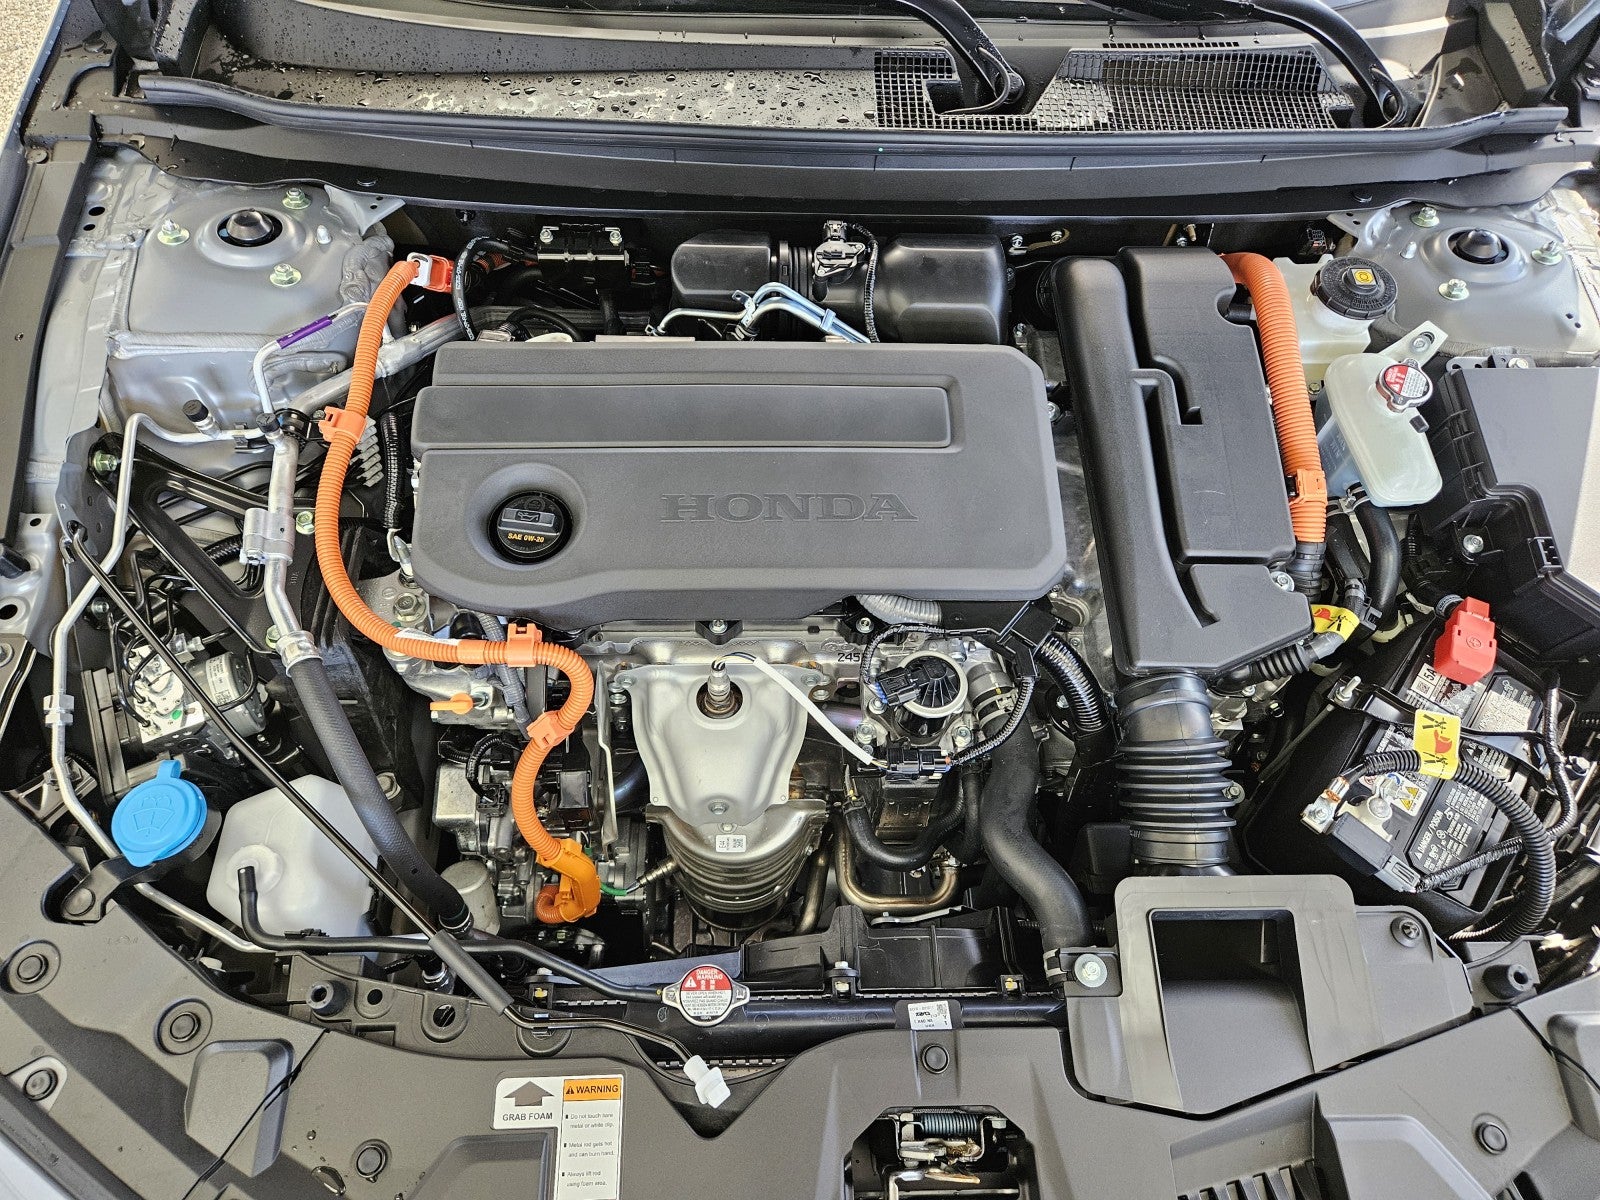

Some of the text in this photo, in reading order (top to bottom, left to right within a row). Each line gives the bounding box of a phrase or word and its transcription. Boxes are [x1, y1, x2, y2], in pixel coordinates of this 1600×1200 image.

[660, 493, 919, 523] HONDA
[507, 532, 545, 543] SAE 0W-20
[1424, 667, 1437, 682] 5A
[1417, 831, 1432, 853] DANGER
[576, 1084, 619, 1094] WARNING
[502, 1112, 553, 1121] GRAB FOAM
